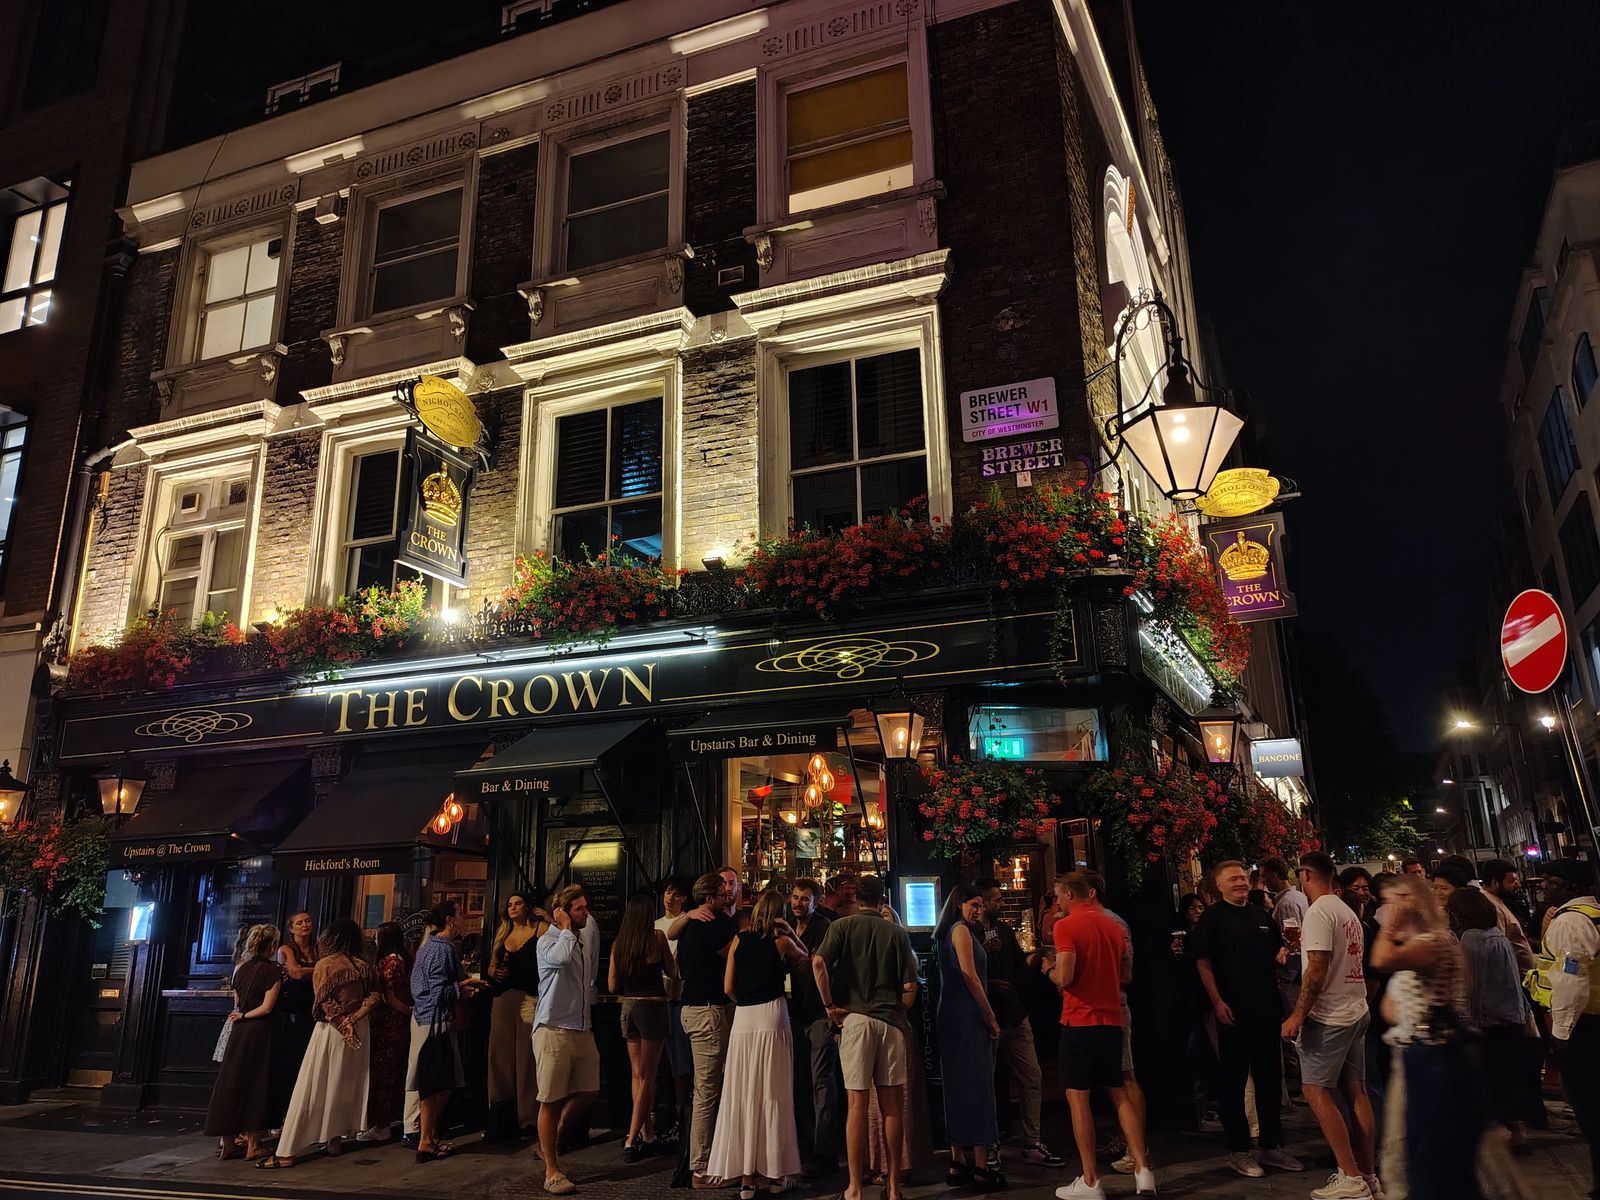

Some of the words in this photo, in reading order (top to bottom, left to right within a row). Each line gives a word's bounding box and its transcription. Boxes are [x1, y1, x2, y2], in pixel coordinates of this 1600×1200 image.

[969, 387, 1027, 408] BREWER
[970, 403, 1021, 423] STREET
[1027, 399, 1049, 414] W1
[972, 430, 985, 438] CITY
[998, 420, 1044, 433] WESTMINSTER
[982, 438, 1062, 461] BREWER
[982, 453, 1063, 477] STREET
[1204, 484, 1270, 503] NICHOLSON'S
[426, 524, 447, 541] THE
[411, 531, 457, 562] CROWN
[1236, 583, 1262, 593] THE
[328, 687, 429, 733] THE
[448, 663, 657, 721] CROWN
[690, 738, 736, 754] Upstairs
[739, 736, 759, 748] Bar
[762, 734, 773, 746] &
[777, 732, 816, 746] Dining
[481, 782, 499, 793] Bar
[502, 780, 511, 792] &
[514, 777, 549, 792] Dining
[124, 844, 155, 859] Upstairs
[156, 844, 167, 857] @
[168, 843, 182, 854] The
[184, 842, 211, 853] Crown
[305, 858, 350, 871] Hickford's
[353, 857, 380, 869] Room
